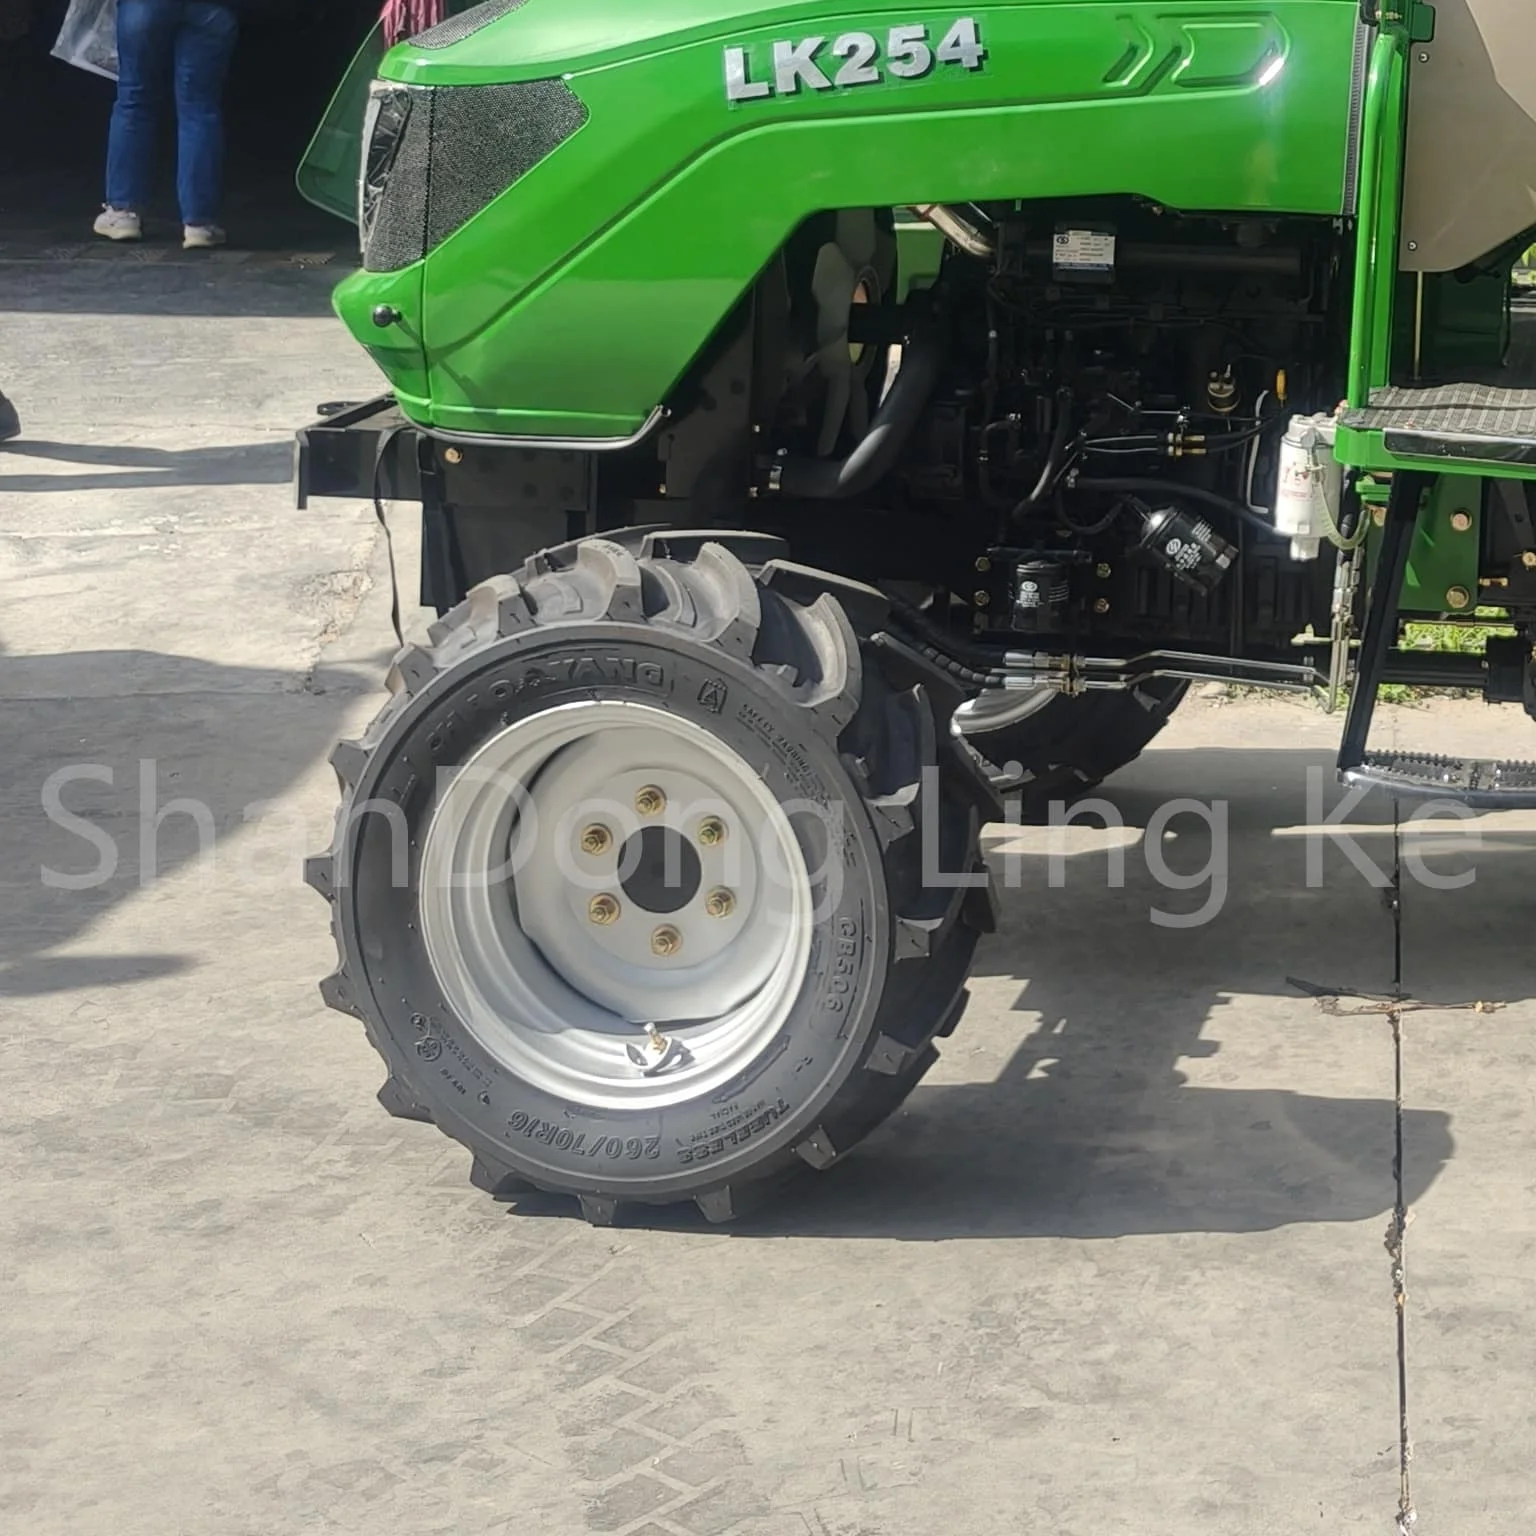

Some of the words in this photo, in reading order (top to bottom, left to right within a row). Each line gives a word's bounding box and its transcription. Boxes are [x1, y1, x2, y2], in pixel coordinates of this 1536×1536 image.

[723, 17, 985, 101] LK254
[825, 916, 857, 1012] CB506
[507, 1109, 662, 1161] 260/70R16
